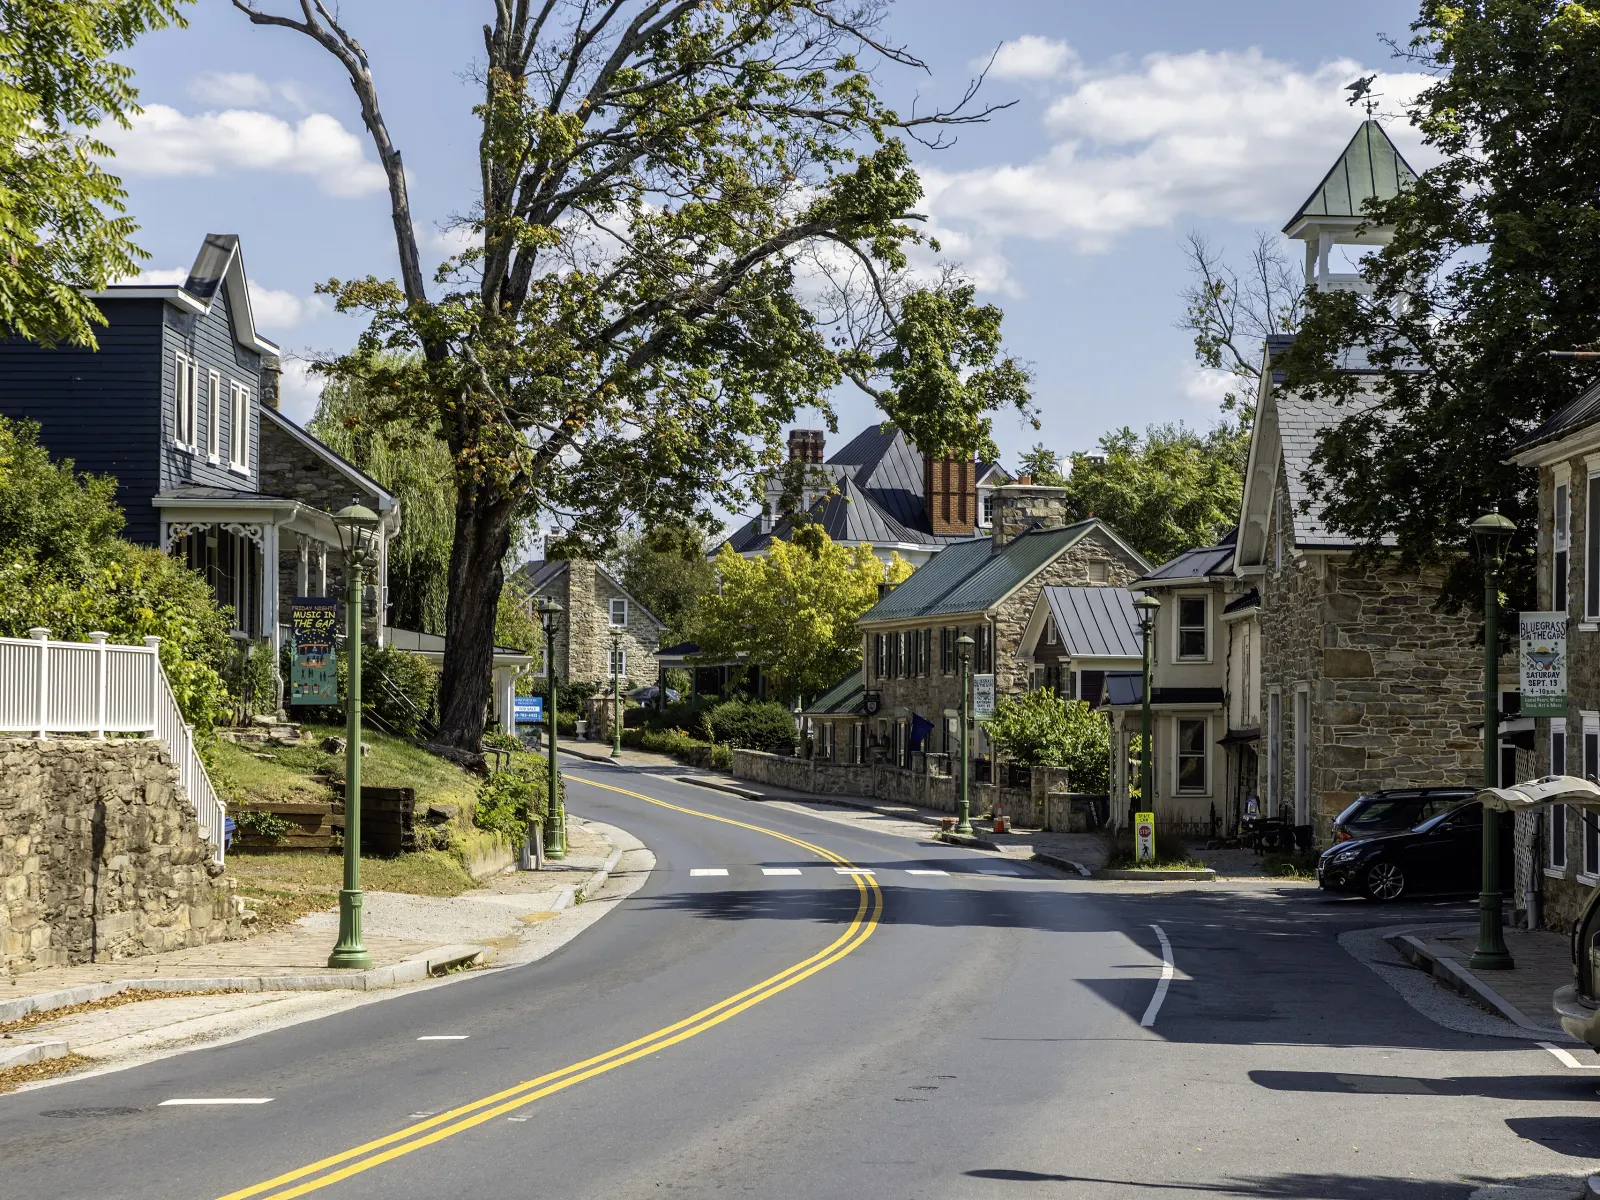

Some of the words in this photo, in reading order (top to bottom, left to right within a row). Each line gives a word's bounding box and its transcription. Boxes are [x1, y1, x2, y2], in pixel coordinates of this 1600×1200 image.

[294, 620, 313, 628] THE
[316, 620, 335, 628] GAP
[1520, 622, 1566, 638] BLUEGRASS
[1532, 631, 1546, 640] THE
[1547, 631, 1560, 640] GAP
